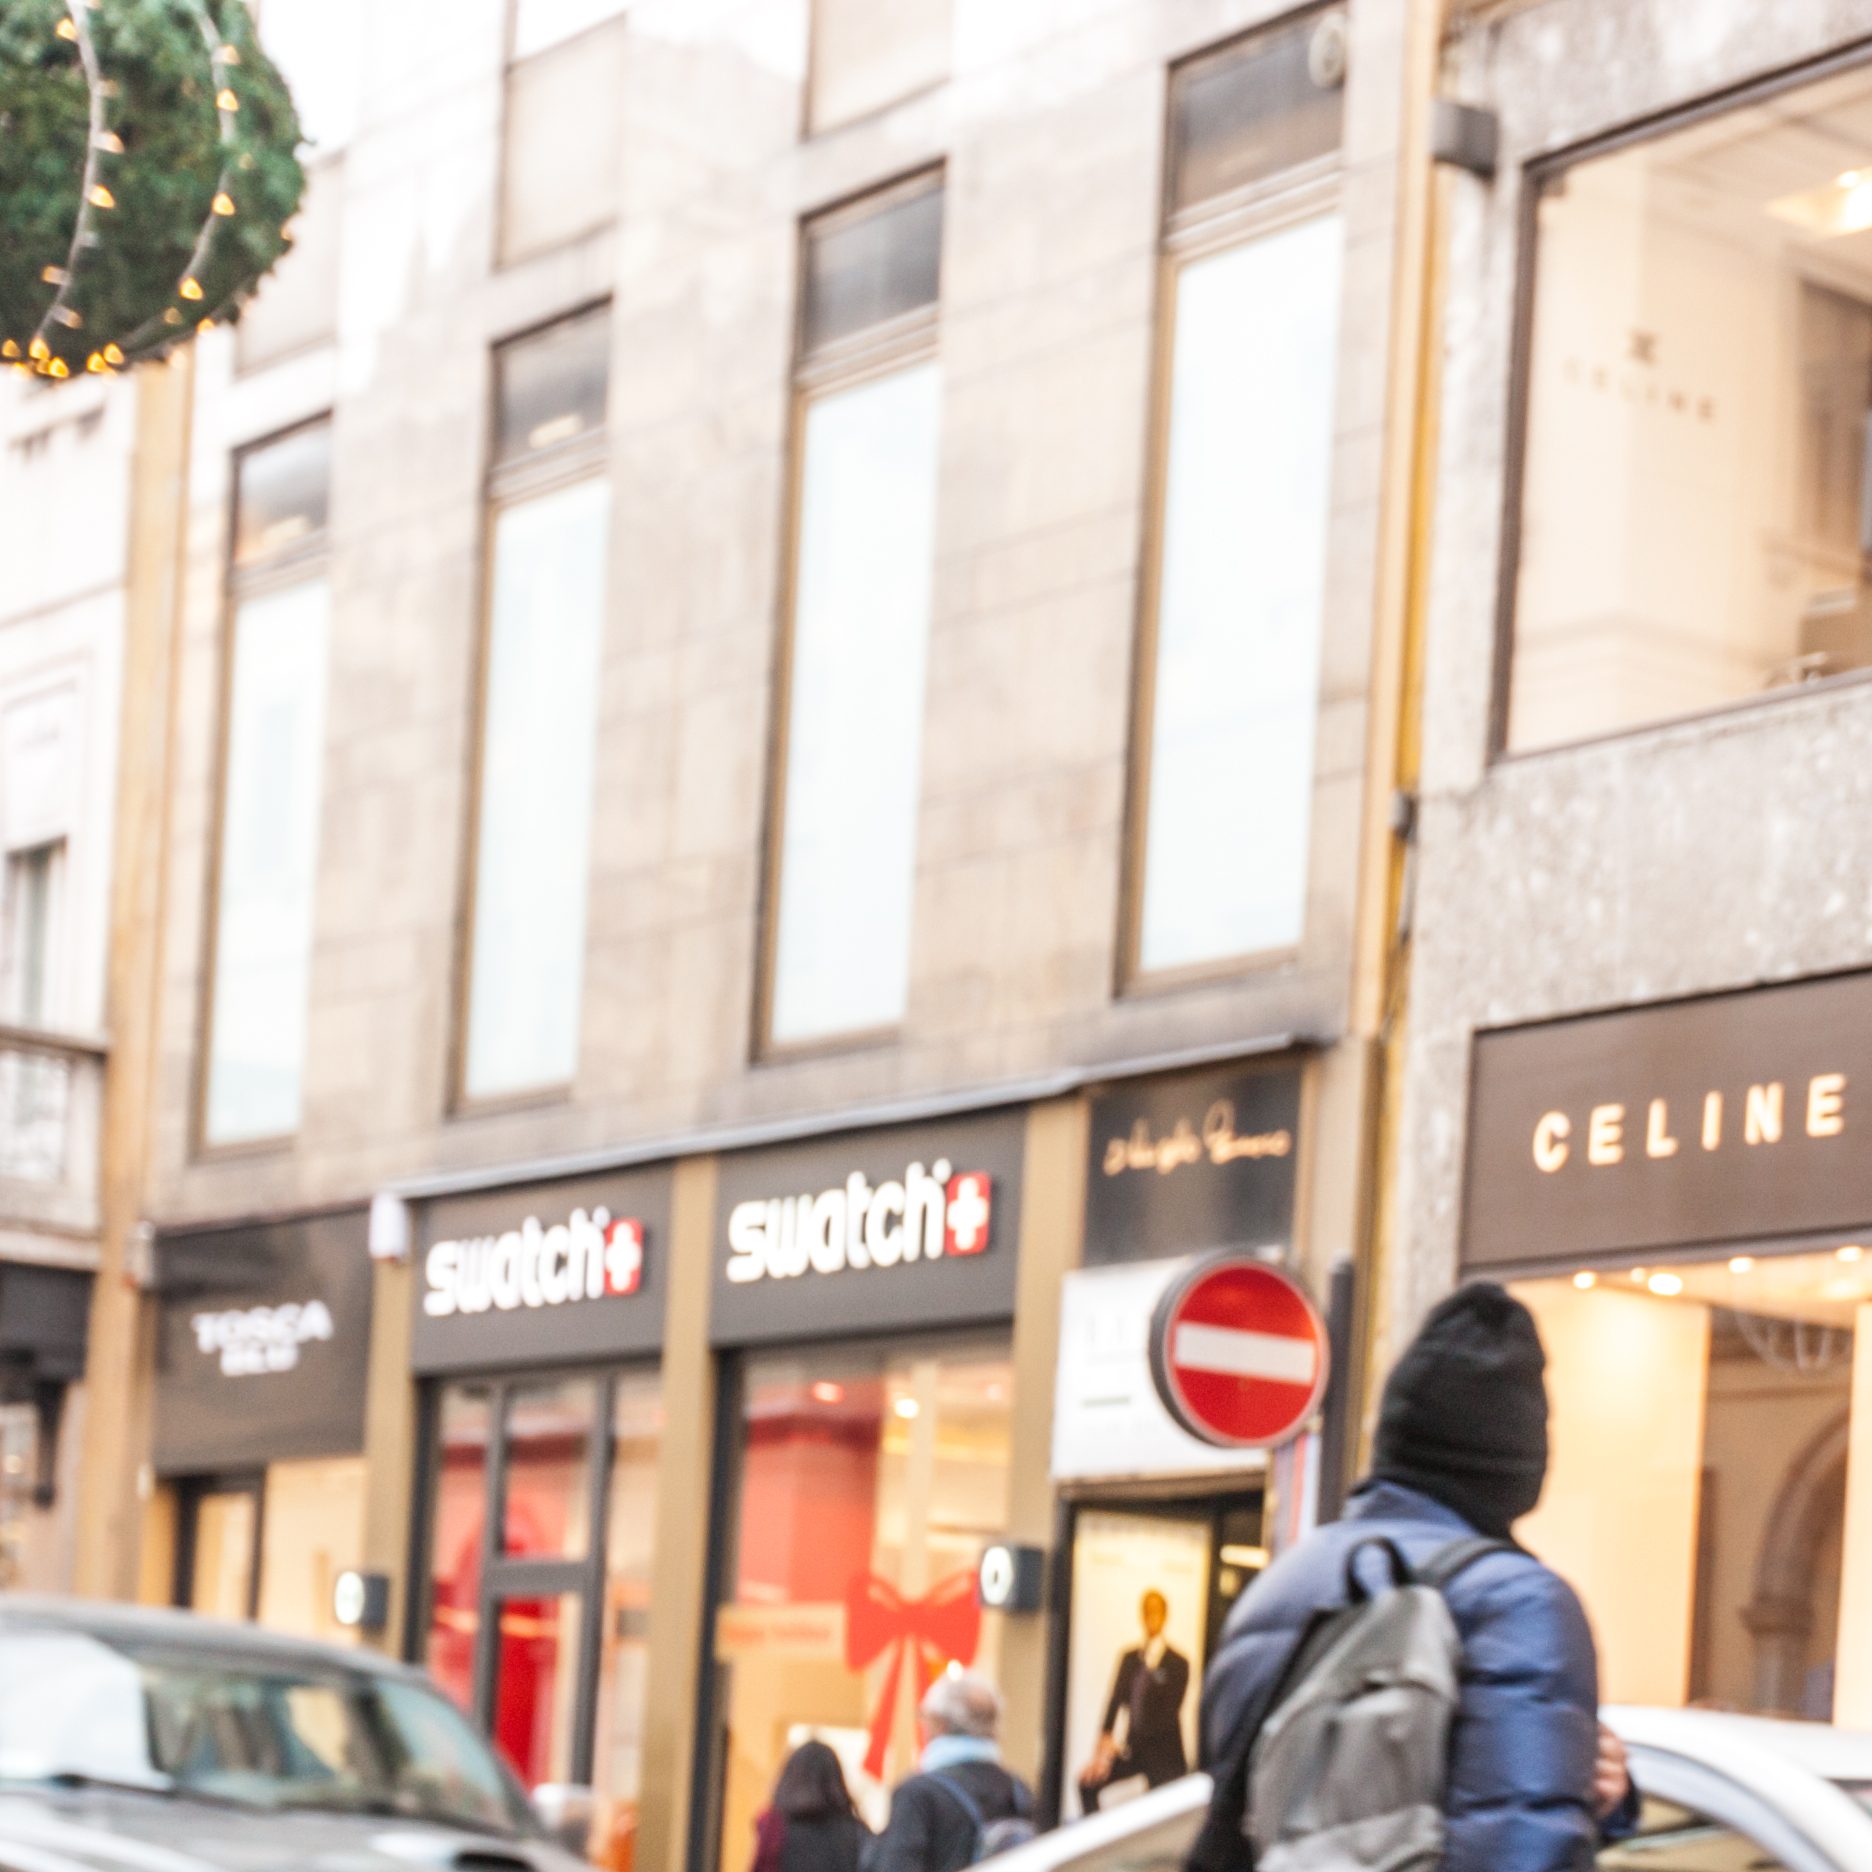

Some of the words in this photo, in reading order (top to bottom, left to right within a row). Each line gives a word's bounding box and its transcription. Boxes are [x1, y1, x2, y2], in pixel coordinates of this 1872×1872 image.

[1531, 1074, 1848, 1173] CELINE
[424, 1208, 606, 1317] swatch
[727, 1162, 947, 1285] swatch
